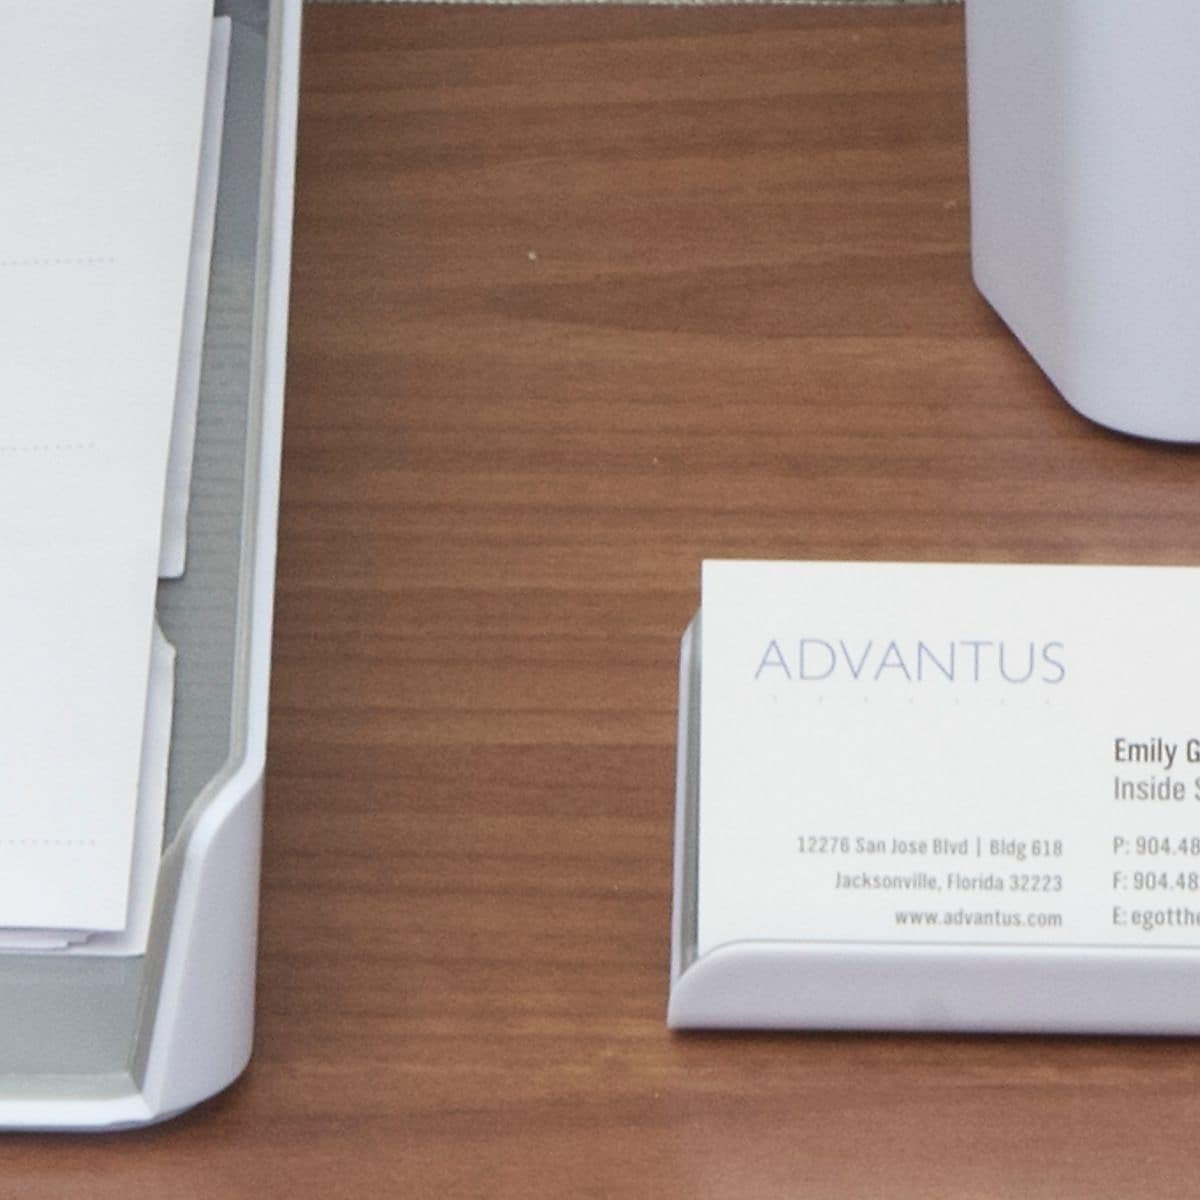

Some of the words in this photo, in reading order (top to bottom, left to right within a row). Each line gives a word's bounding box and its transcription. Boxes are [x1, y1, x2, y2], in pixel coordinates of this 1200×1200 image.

[755, 639, 1065, 684] ADVANTUS
[1114, 737, 1178, 770] Emily
[1114, 776, 1186, 802] Inside
[798, 836, 850, 853] 12276
[856, 837, 886, 854] San
[892, 838, 927, 855] Jose
[933, 838, 968, 855] Blvd
[990, 839, 1026, 861] Bldg
[1031, 840, 1062, 857] 618
[1113, 836, 1129, 854] P:
[836, 872, 941, 891] Jacksonville,
[947, 873, 1004, 891] Florida
[1010, 874, 1062, 892] 32223
[1113, 871, 1126, 889] F:
[896, 909, 1062, 928] www.advantus.com
[1113, 906, 1126, 925] E:
